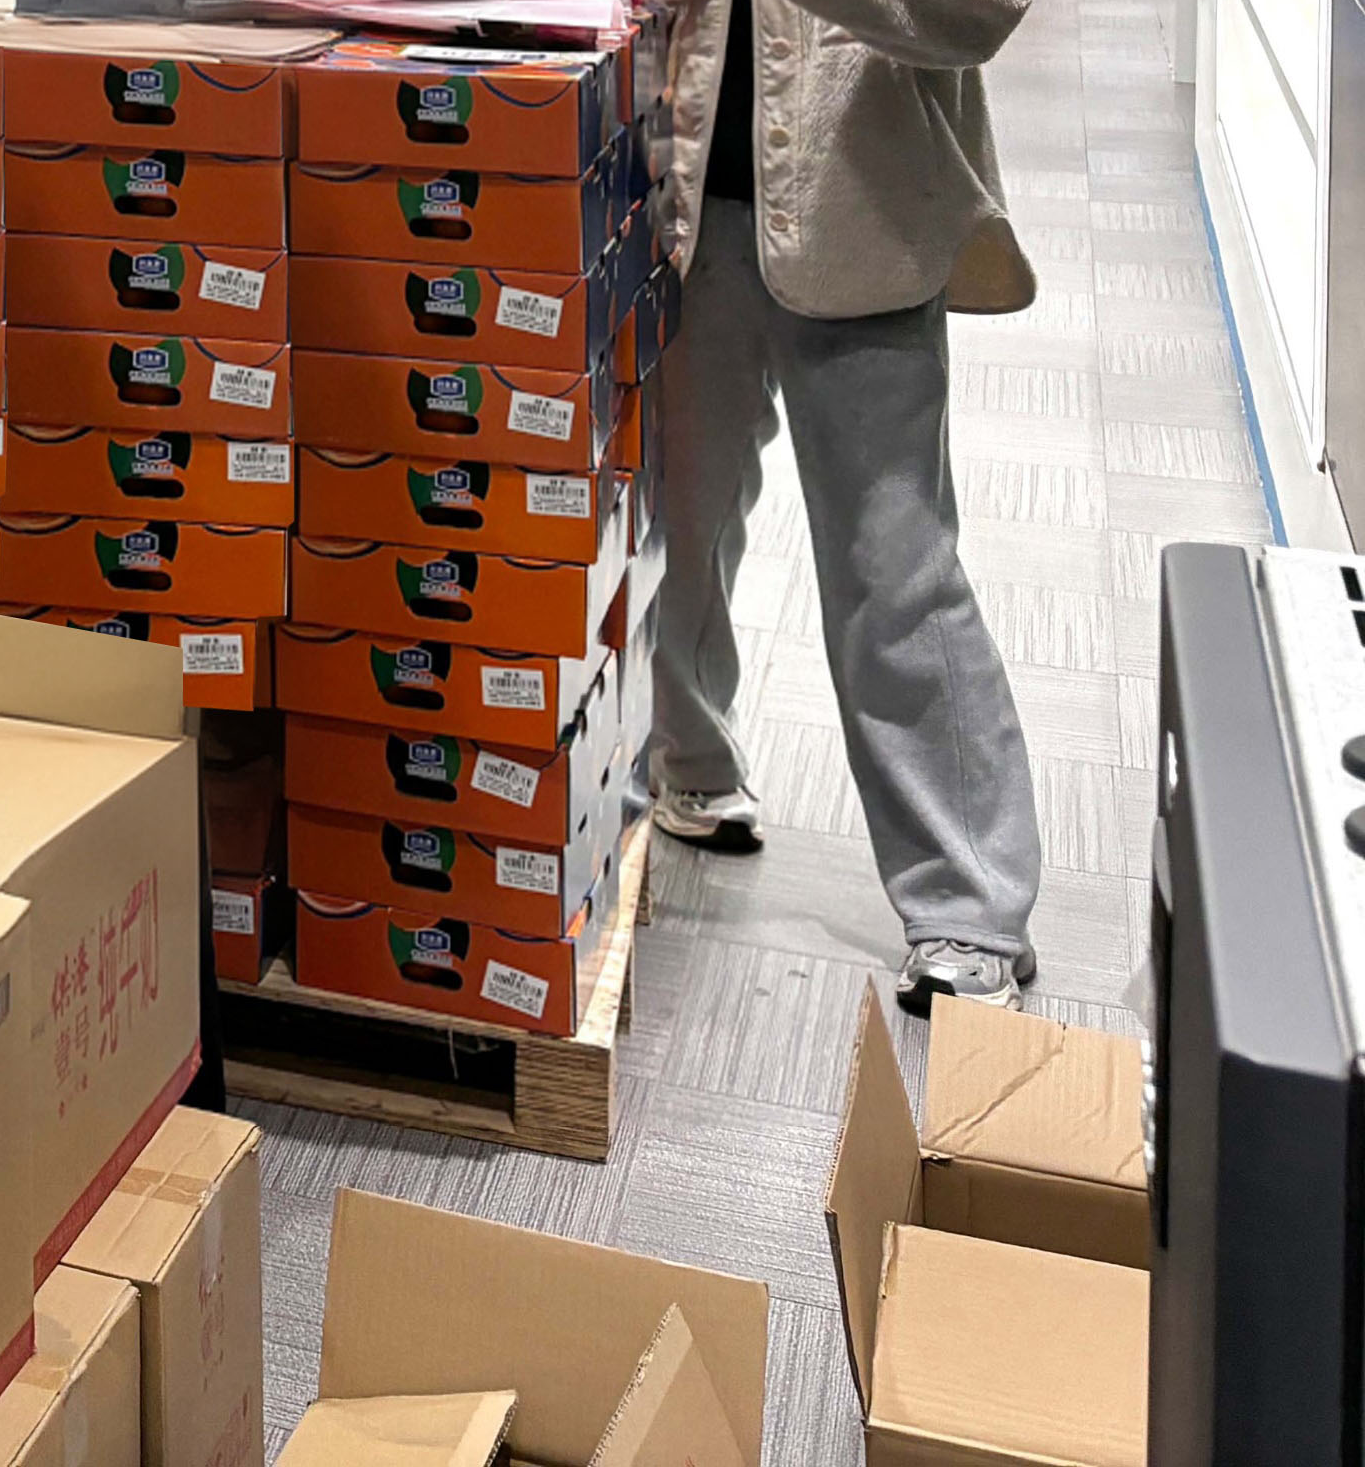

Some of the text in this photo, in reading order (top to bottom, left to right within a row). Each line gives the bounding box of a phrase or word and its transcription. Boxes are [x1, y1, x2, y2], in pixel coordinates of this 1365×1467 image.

[50, 937, 90, 1021] 供港
[97, 865, 159, 1061] 纯牛奶
